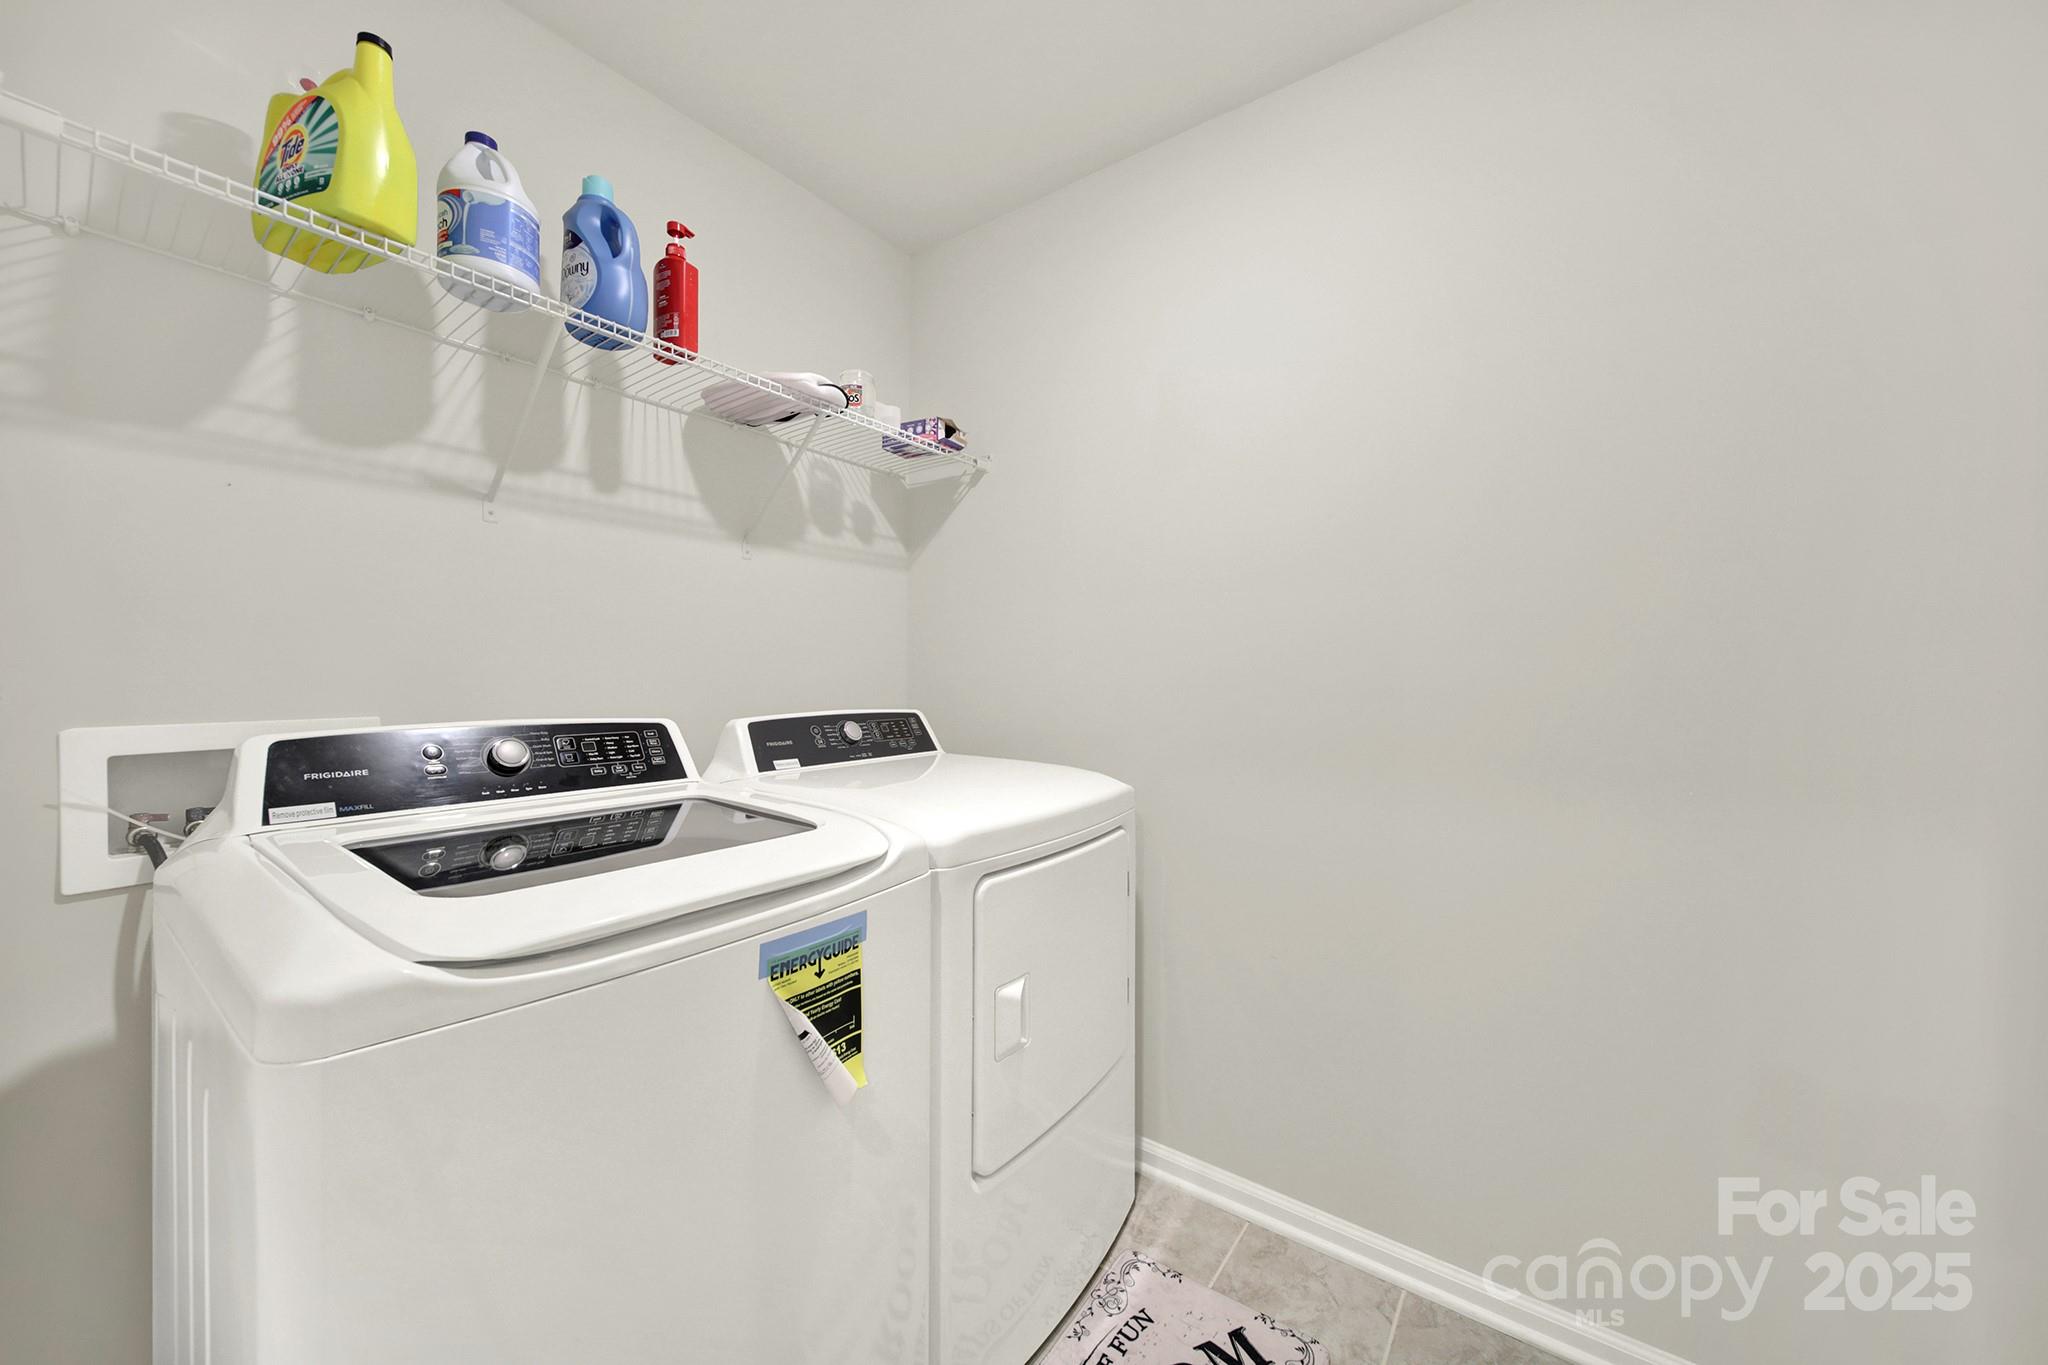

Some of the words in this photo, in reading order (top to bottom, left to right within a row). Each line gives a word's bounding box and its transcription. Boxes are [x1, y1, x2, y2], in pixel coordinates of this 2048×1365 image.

[281, 135, 305, 168] Tide
[303, 769, 369, 780] FRIGIDAIRE
[272, 811, 295, 819] Remove
[296, 808, 322, 818] protective
[323, 806, 334, 815] film
[770, 934, 860, 981] ENERGYGUIDE
[1107, 1307, 1155, 1357] FUN
